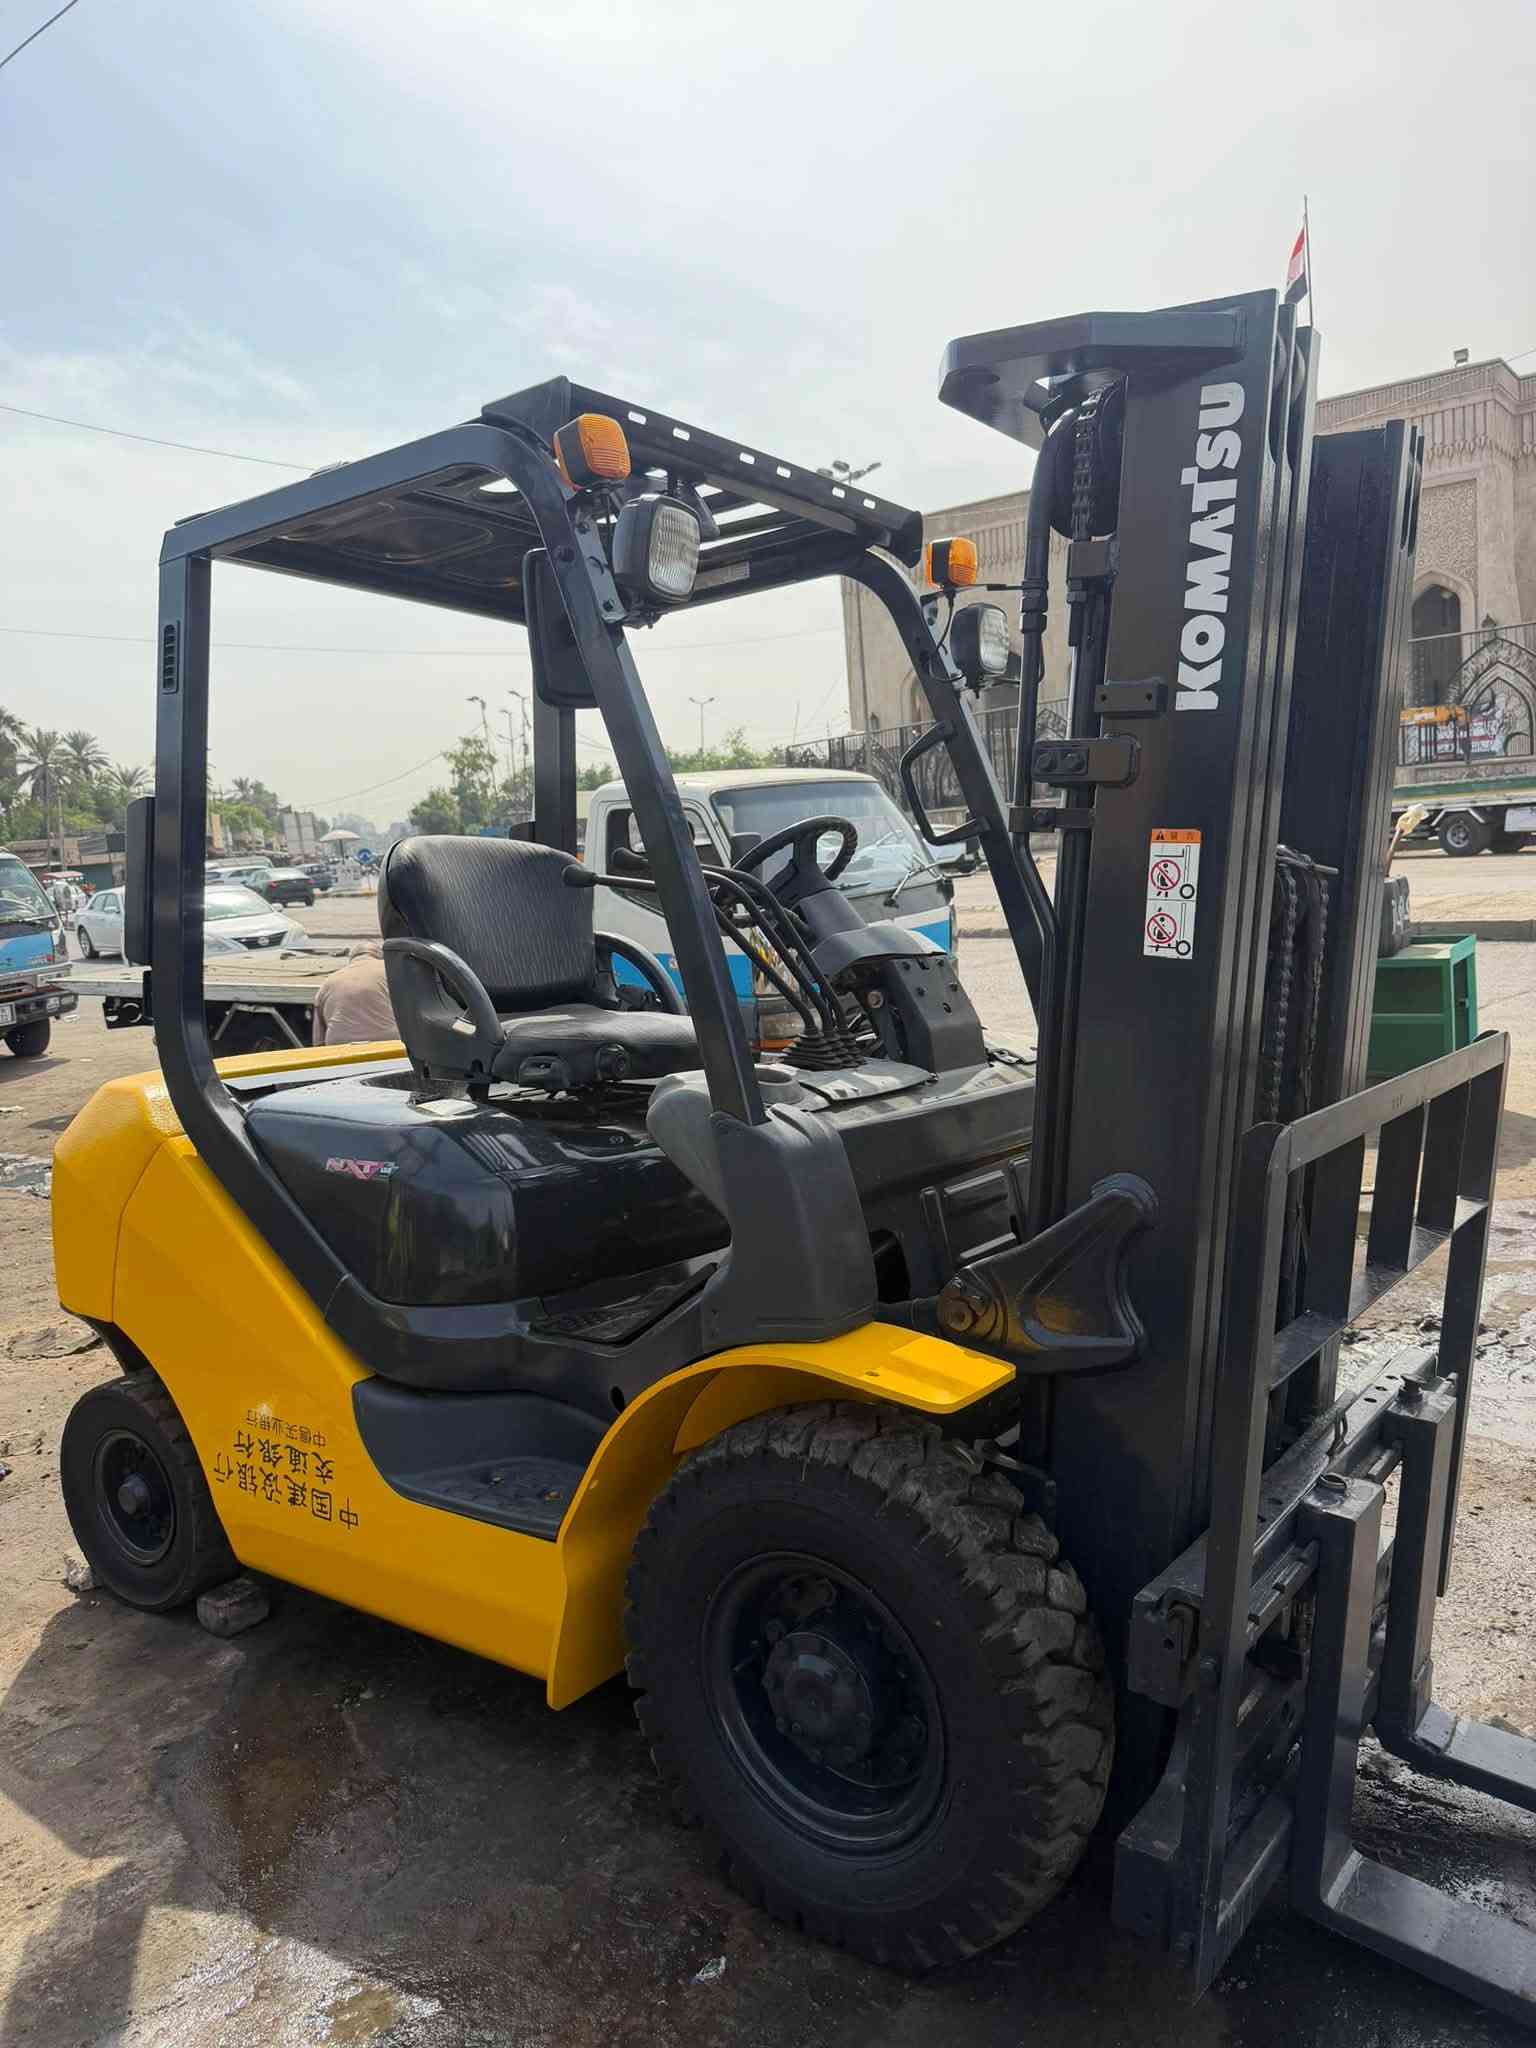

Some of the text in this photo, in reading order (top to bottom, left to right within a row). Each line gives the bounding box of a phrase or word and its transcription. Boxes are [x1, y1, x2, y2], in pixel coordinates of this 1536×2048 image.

[1175, 381, 1246, 711] KOMATSU
[213, 1452, 359, 1530] 中国建设银行
